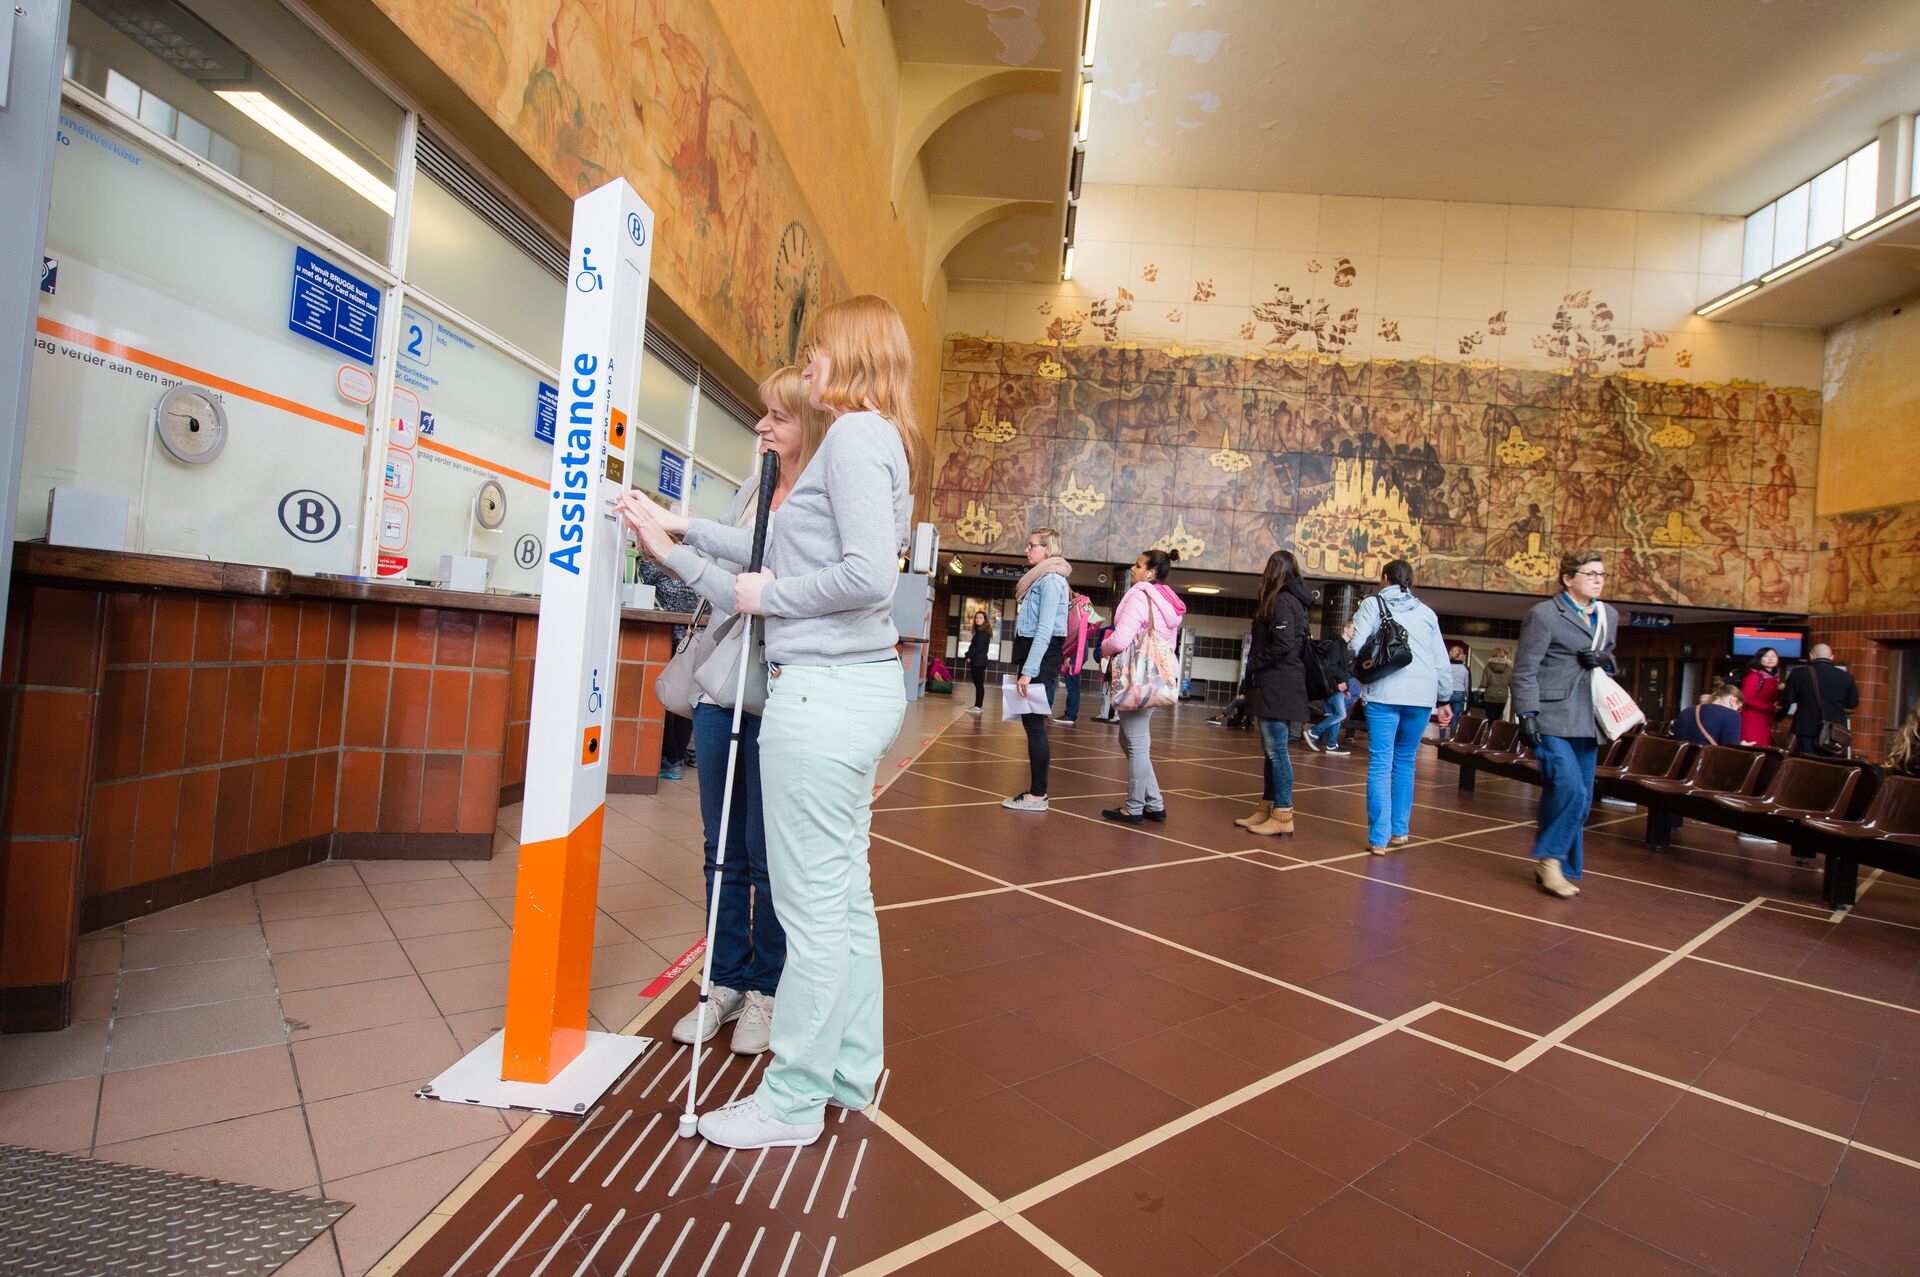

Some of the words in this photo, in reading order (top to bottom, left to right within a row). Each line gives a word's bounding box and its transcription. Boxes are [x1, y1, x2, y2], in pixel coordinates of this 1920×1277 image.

[301, 267, 314, 276] met
[314, 273, 323, 283] de
[322, 277, 335, 290] Key
[334, 285, 349, 297] Card
[348, 293, 365, 306] reizen
[365, 302, 378, 312] naar
[310, 261, 329, 278] Vanuit
[329, 272, 356, 291] BRUGGE
[355, 286, 368, 299] kunt
[407, 324, 423, 357] 2
[60, 345, 106, 367] verder
[108, 360, 132, 376] aan
[135, 369, 158, 383] een
[549, 353, 597, 576] Assistance
[662, 966, 683, 979] Hier
